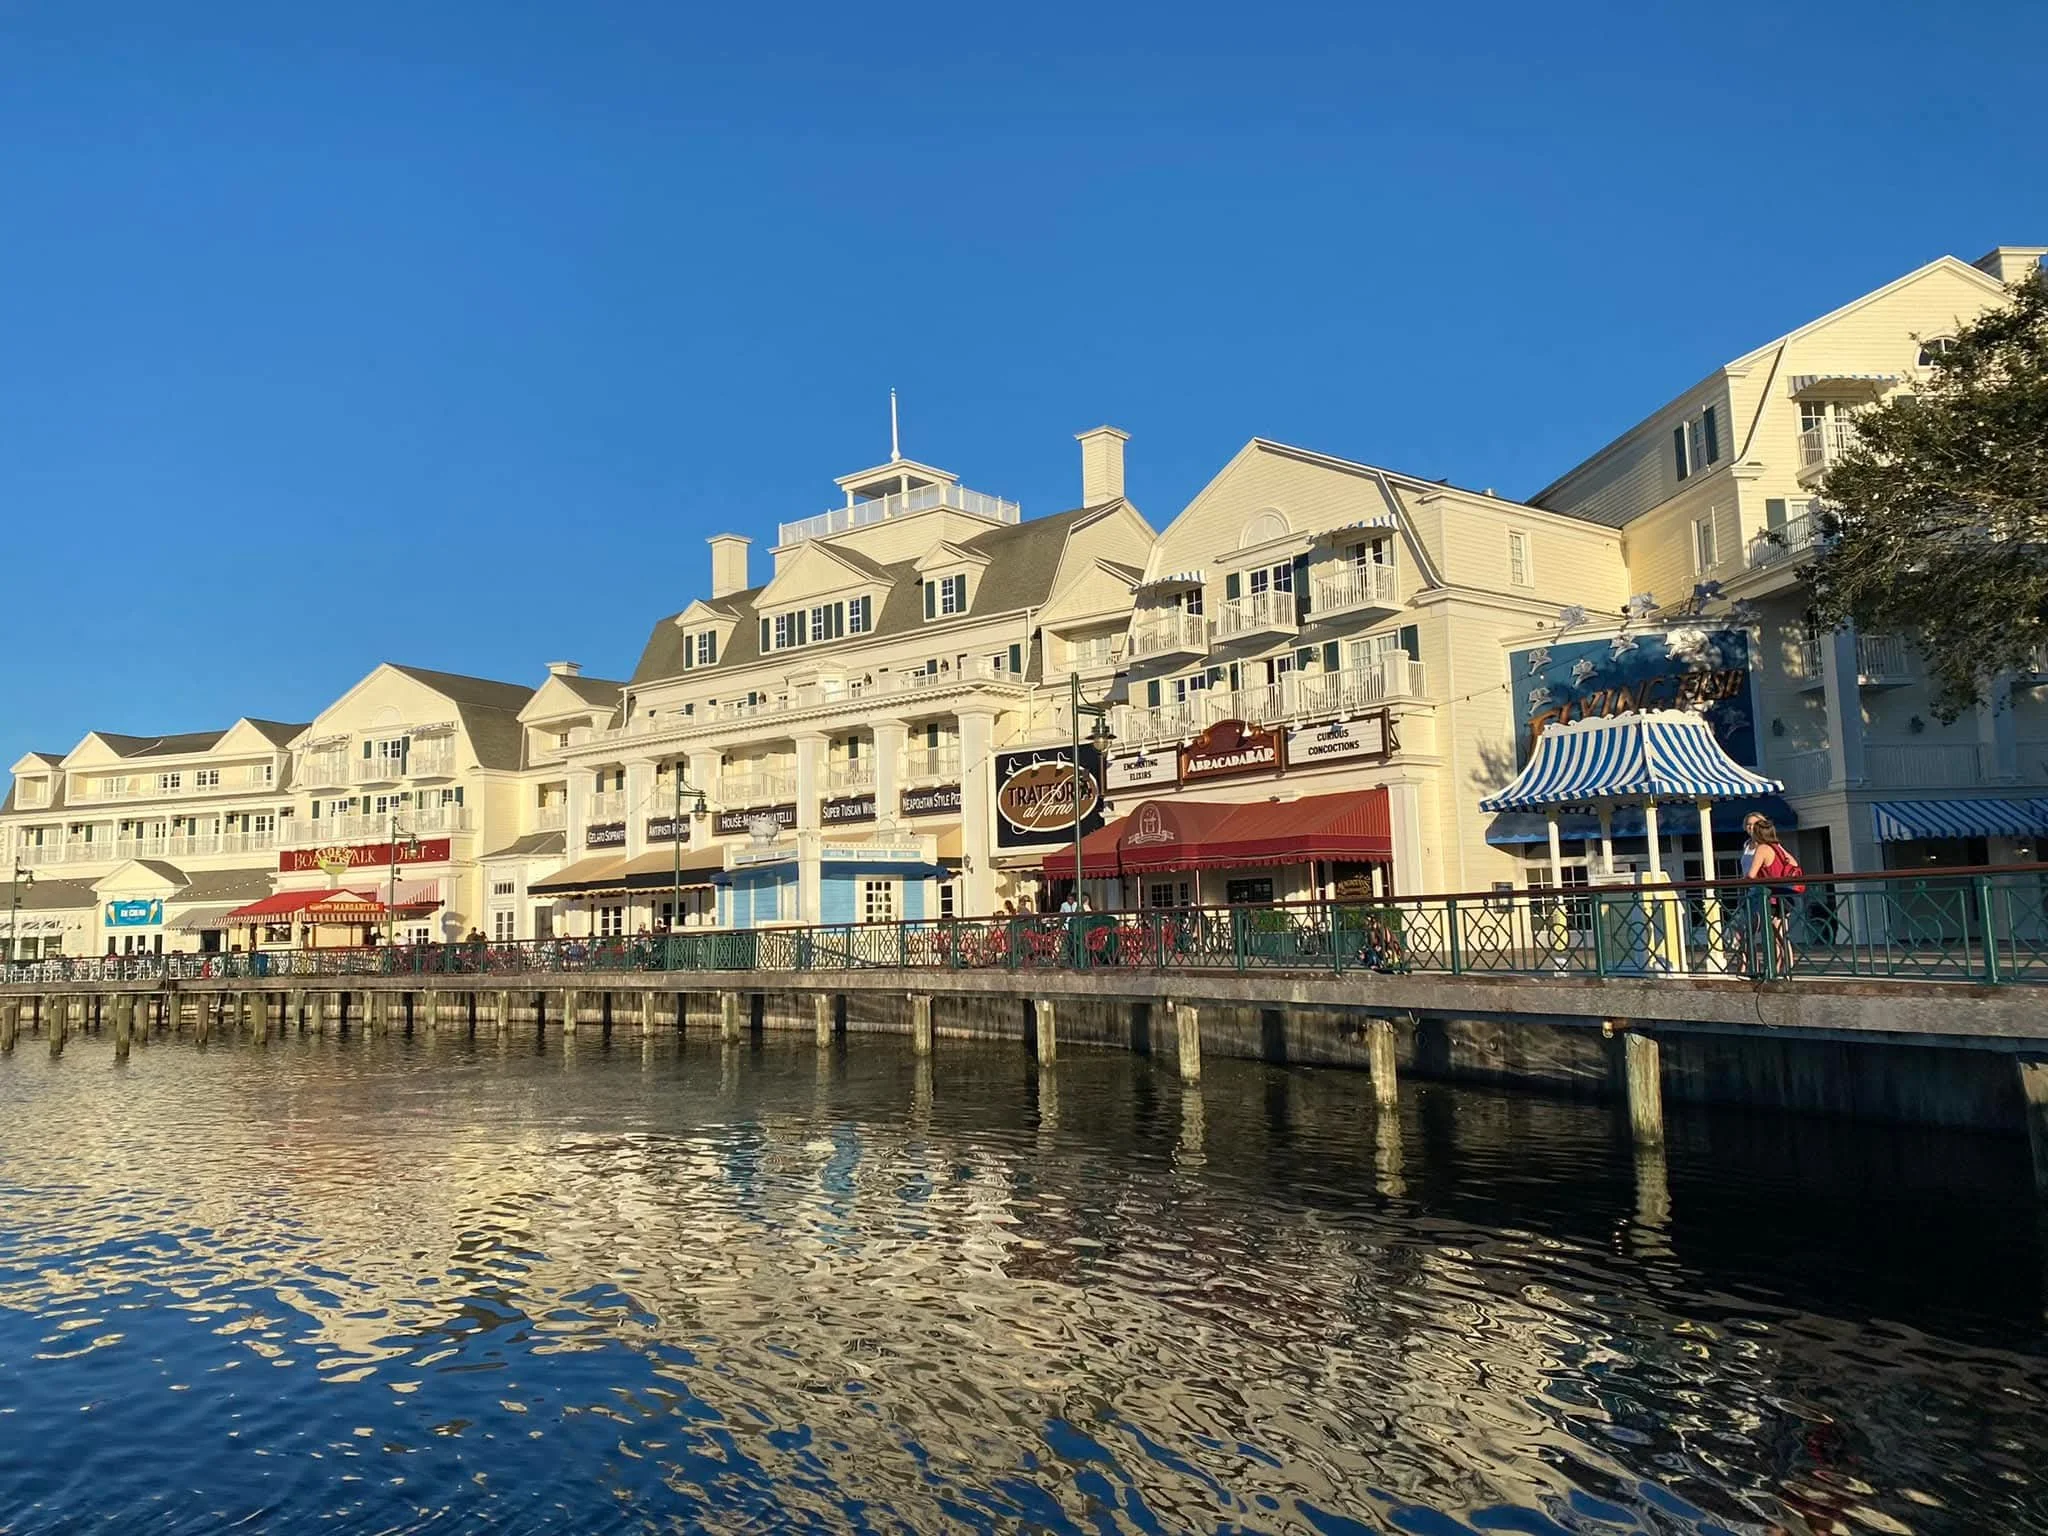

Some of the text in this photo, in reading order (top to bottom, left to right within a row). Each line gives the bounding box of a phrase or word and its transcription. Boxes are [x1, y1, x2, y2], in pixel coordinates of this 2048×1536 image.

[1674, 669, 1744, 709] FISH
[1317, 728, 1349, 742] CURIOUS
[1308, 740, 1360, 756] CONCOCTIONS
[1123, 758, 1158, 771] ENCHANTING
[1187, 747, 1274, 773] ABRACADABAR
[1129, 770, 1152, 781] ELIXIRS
[934, 792, 950, 807] STYLE
[1008, 780, 1093, 807] TRATTORA
[823, 806, 840, 818] SUPER
[841, 804, 862, 816] TUSCAN
[333, 903, 380, 912] MARGARITAS
